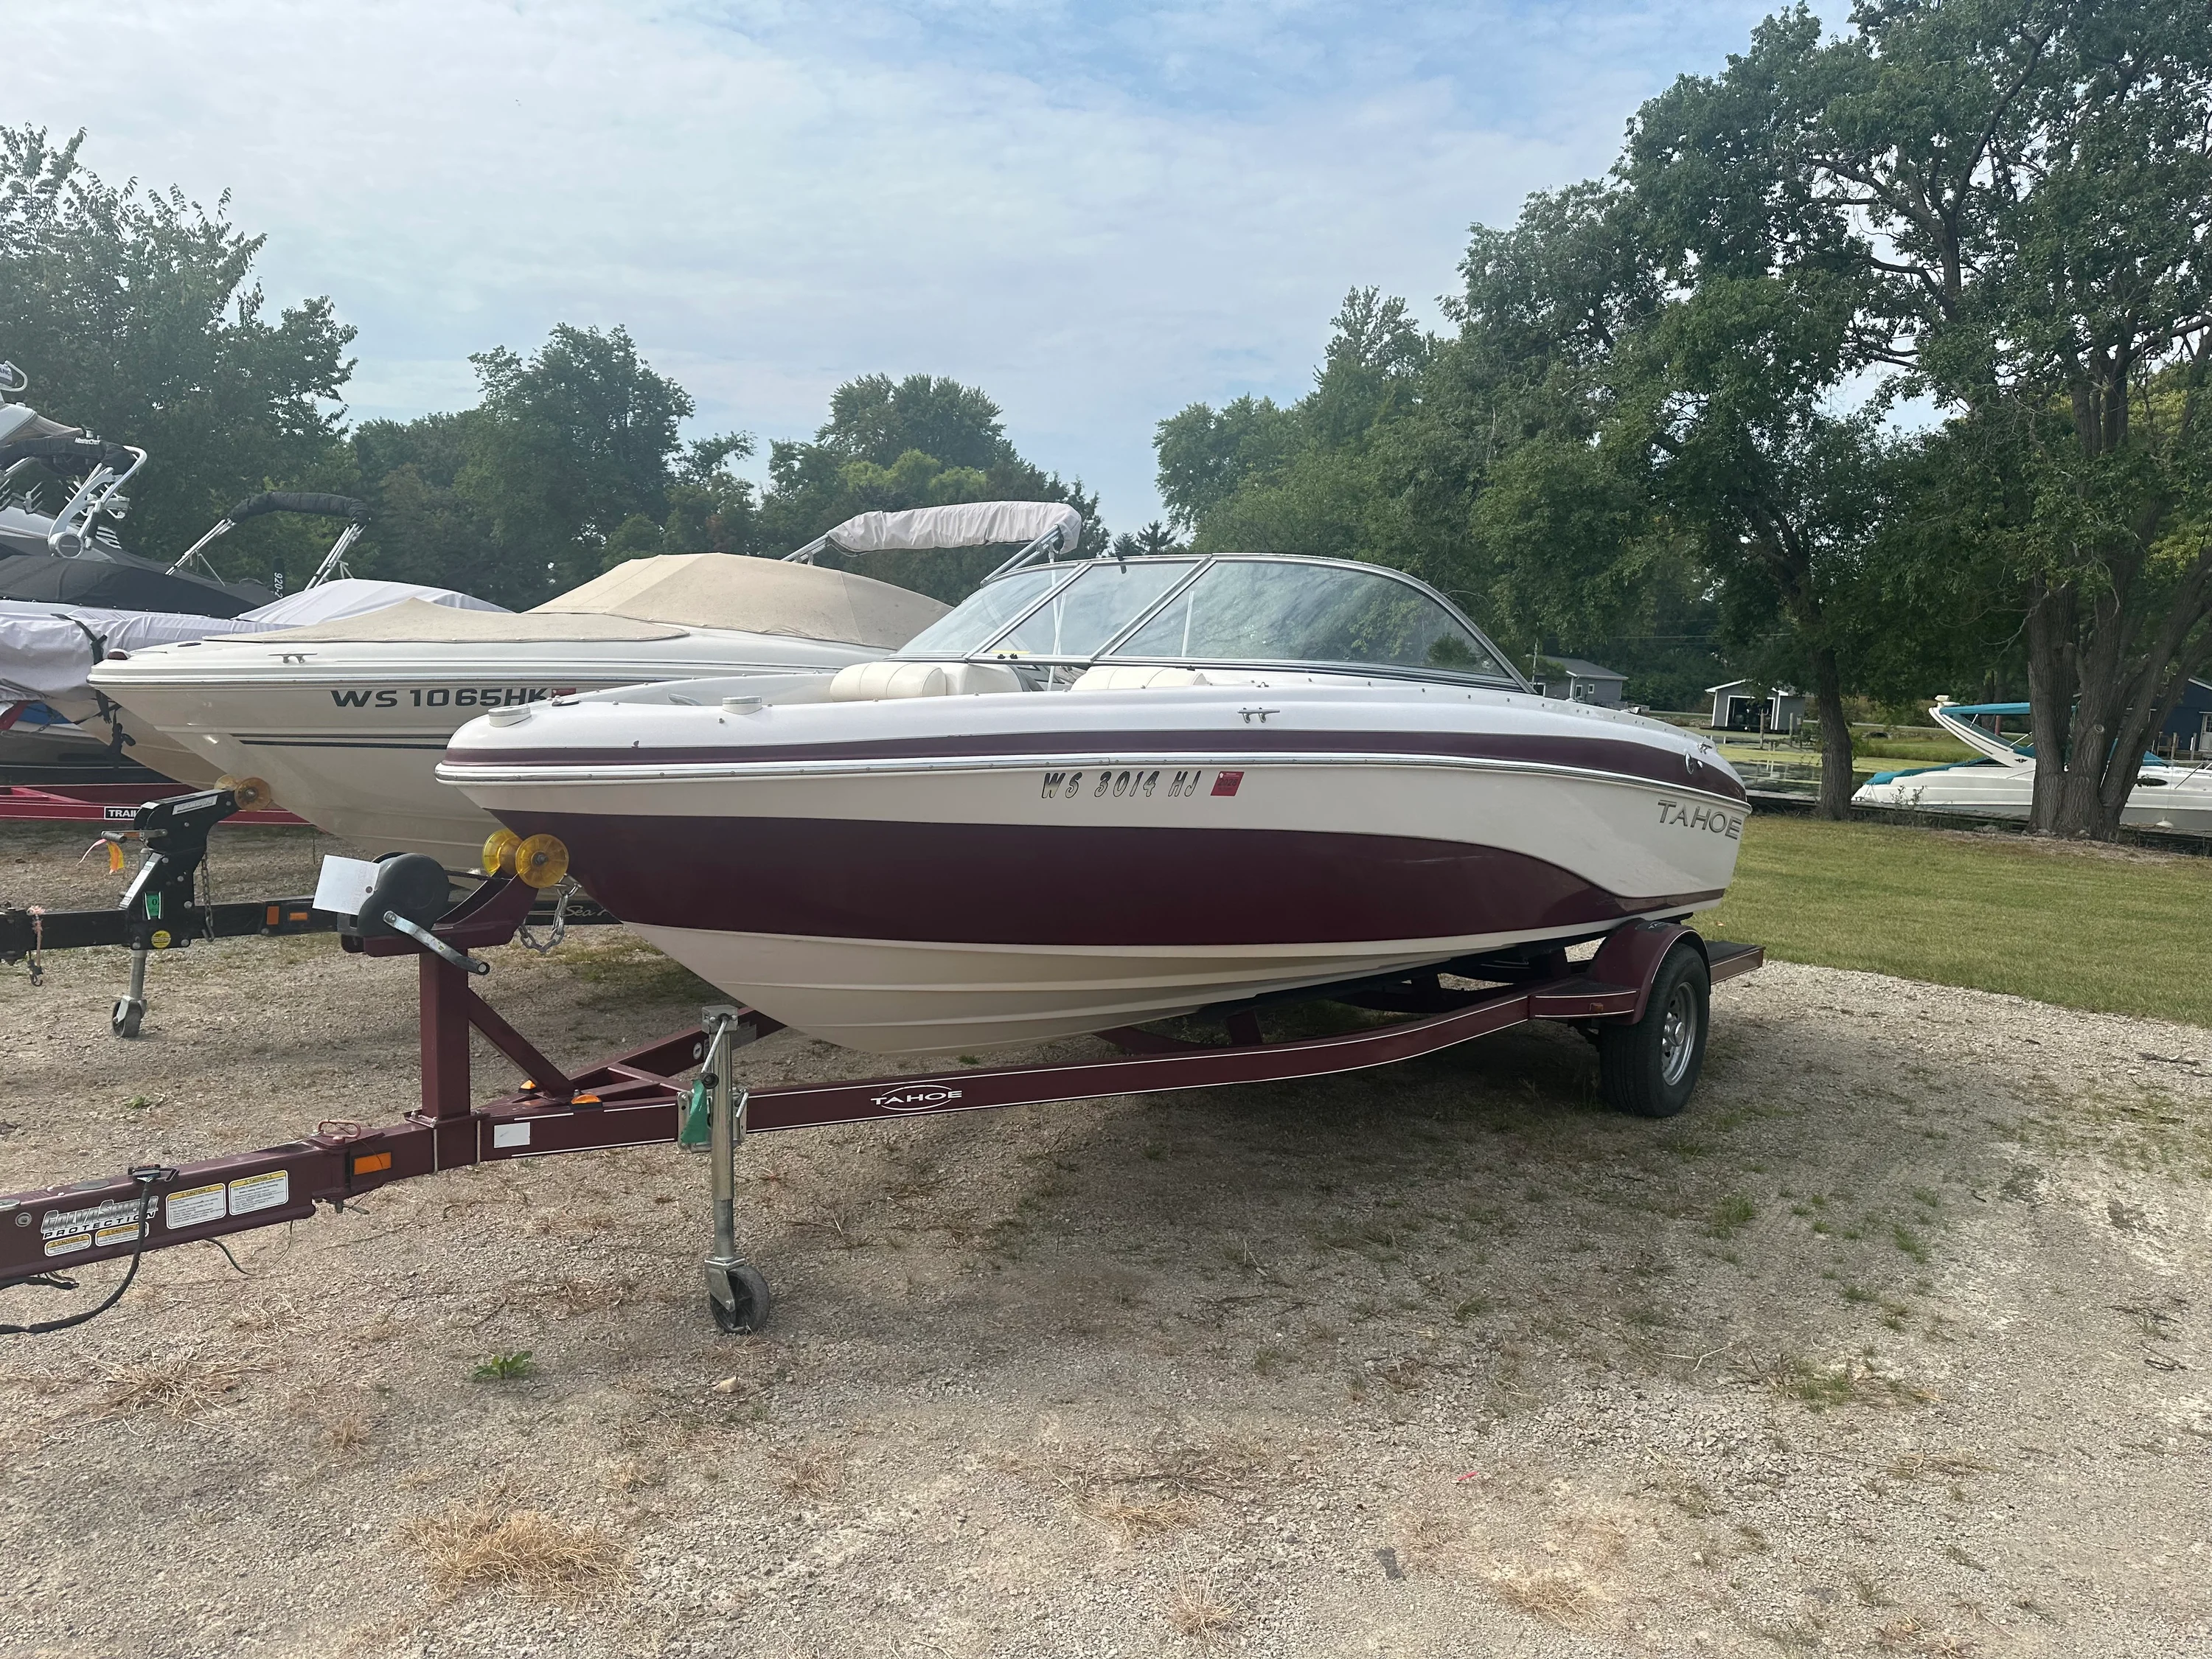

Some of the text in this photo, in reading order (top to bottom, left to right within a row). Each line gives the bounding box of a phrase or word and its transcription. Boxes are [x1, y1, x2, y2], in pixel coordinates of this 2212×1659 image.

[274, 572, 283, 598] 920-2
[330, 690, 397, 708] WS
[1041, 771, 1201, 799] WS 3014 HJ
[1658, 799, 1742, 840] TAHOE
[562, 905, 596, 917] Sea
[870, 1091, 962, 1105] TAHOE
[41, 1195, 159, 1232] GALVASHIED
[57, 1237, 80, 1245] CAUTION
